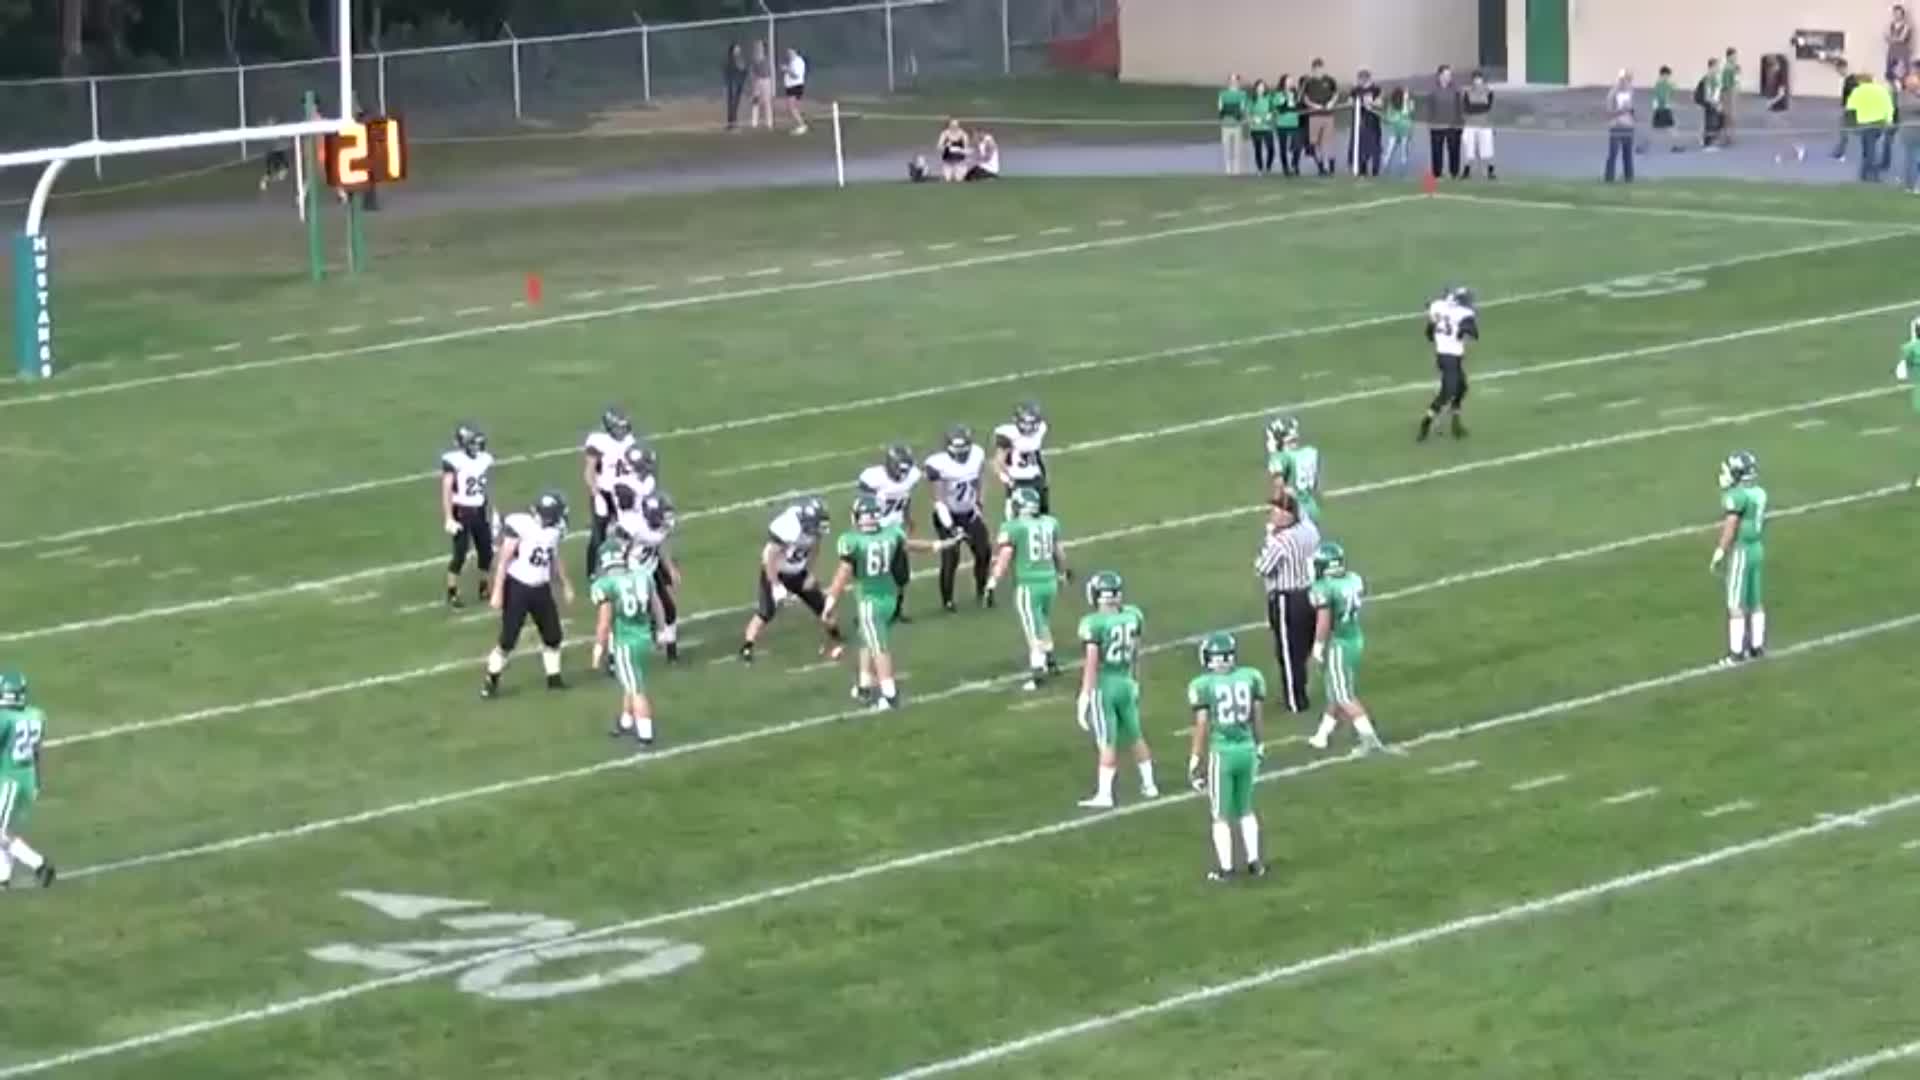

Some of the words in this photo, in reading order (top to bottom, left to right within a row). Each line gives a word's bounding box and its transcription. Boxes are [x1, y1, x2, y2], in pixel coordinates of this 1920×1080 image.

[338, 120, 400, 185] 21
[1215, 682, 1251, 723] 29
[12, 719, 42, 762] 22
